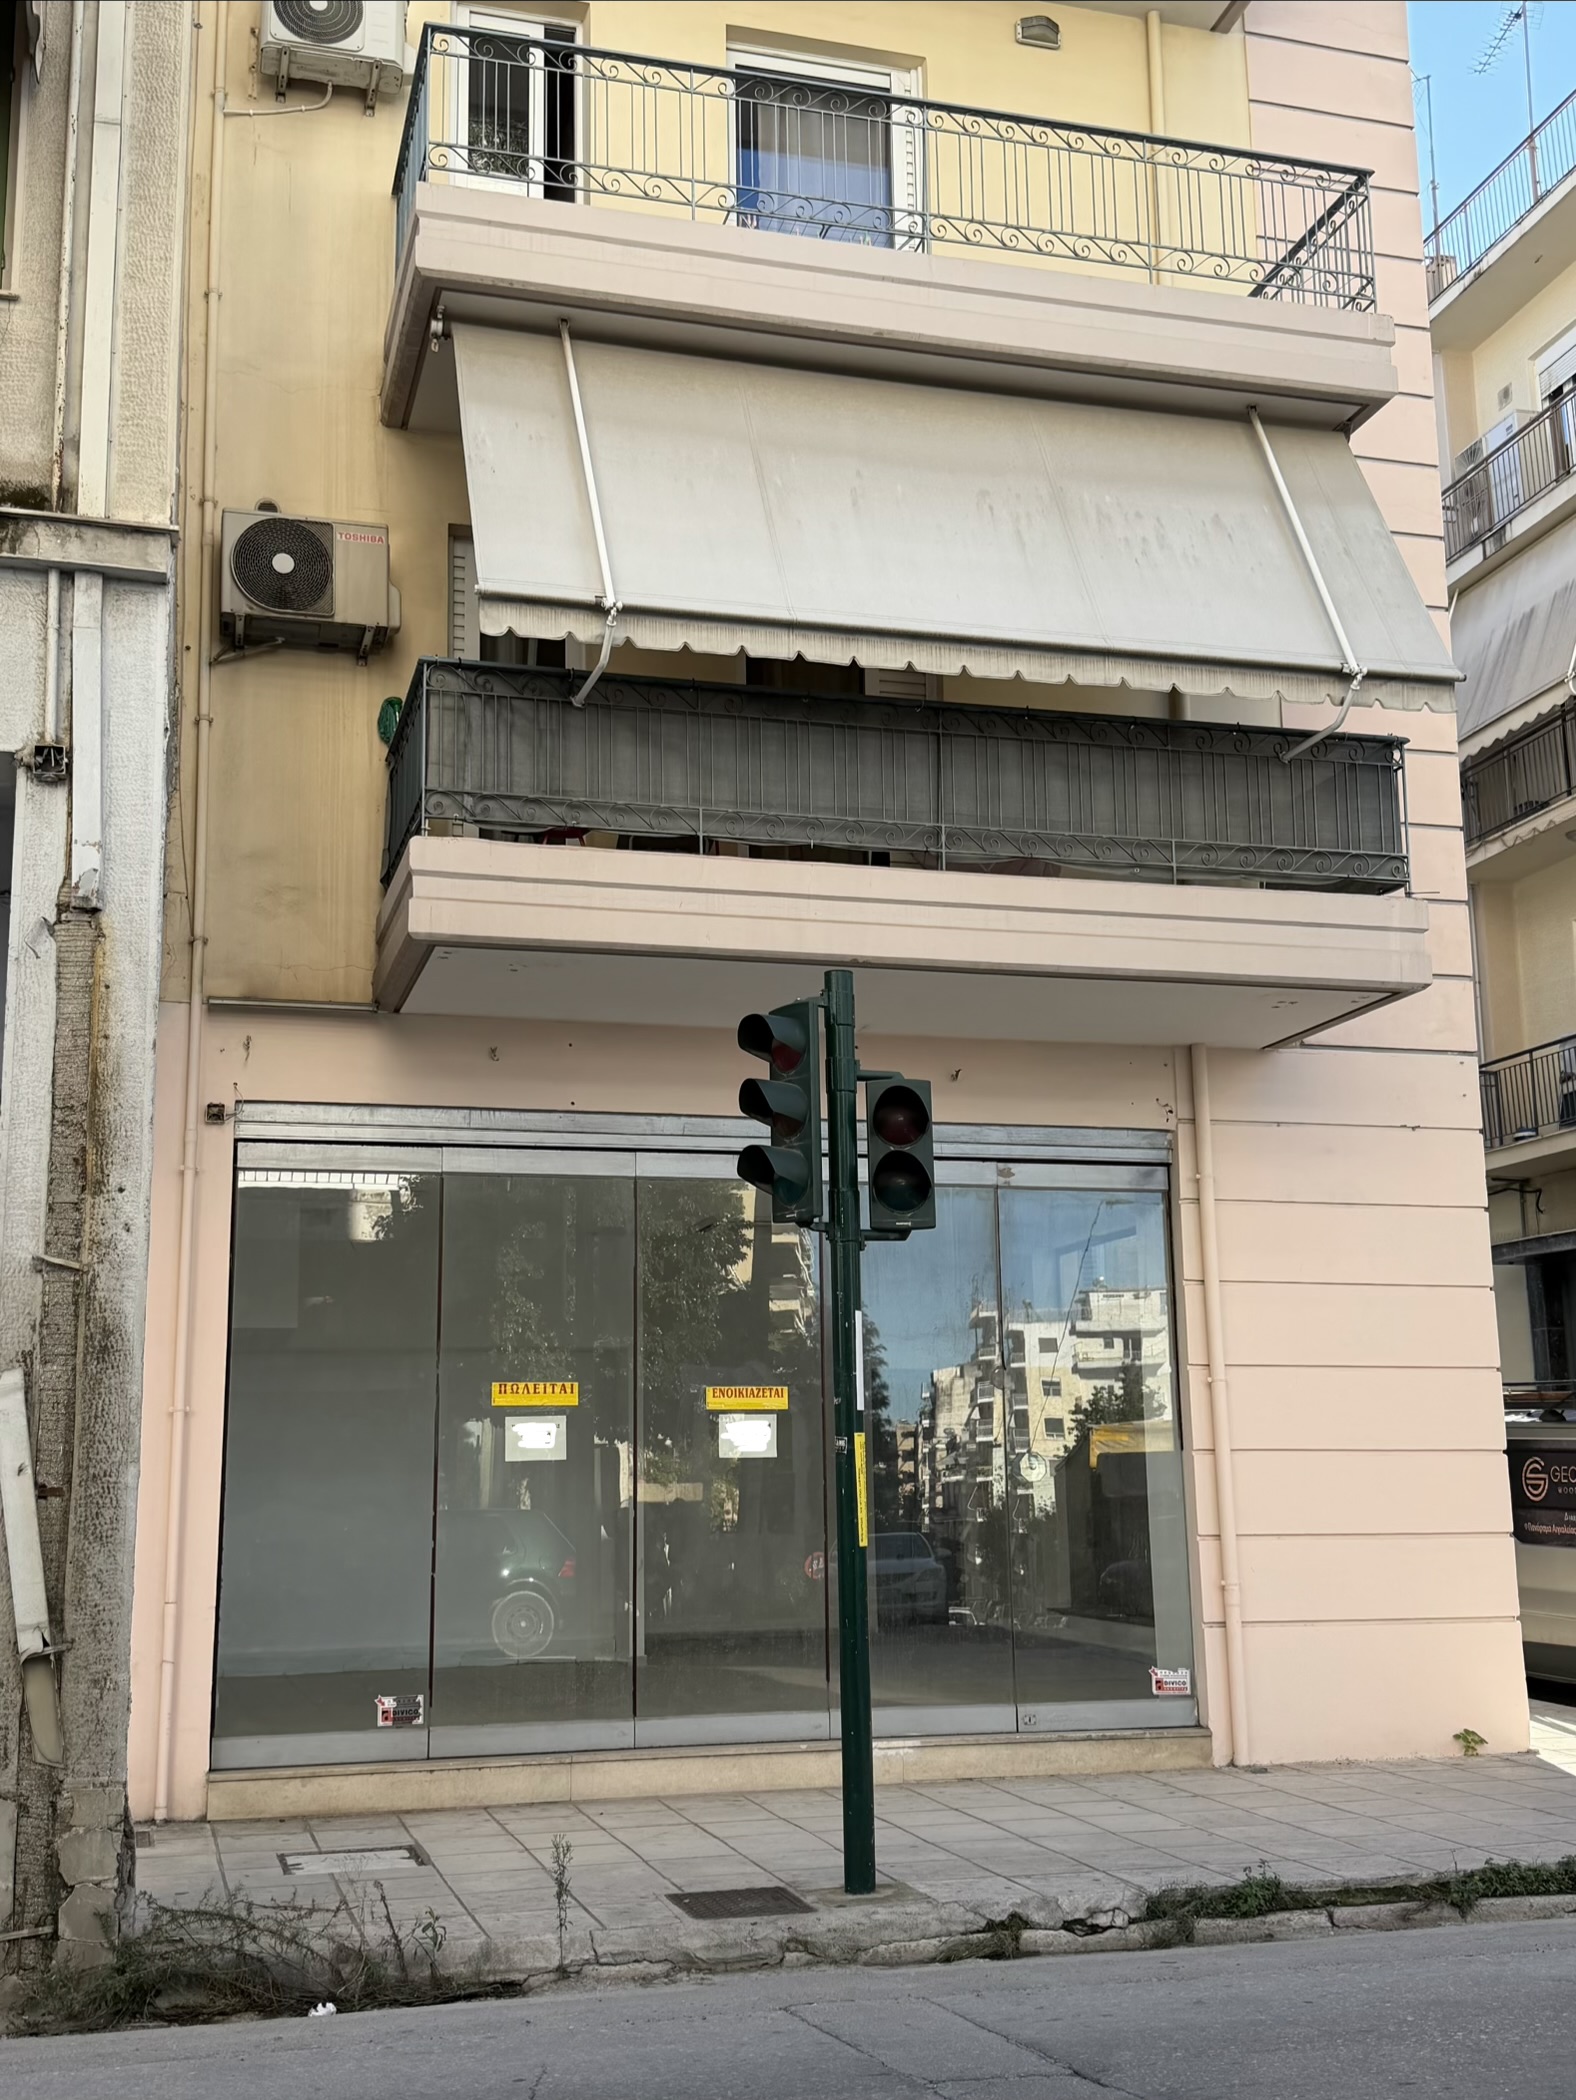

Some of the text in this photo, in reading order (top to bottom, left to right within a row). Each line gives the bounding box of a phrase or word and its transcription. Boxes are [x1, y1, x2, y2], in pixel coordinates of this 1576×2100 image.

[338, 532, 385, 544] TOSHIBA
[498, 1383, 575, 1395] ΠΩΛΕΙΤΑΙ
[712, 1387, 784, 1399] ΕΝΟΙΚΙΑΖΕΤΑΙ
[392, 1708, 419, 1717] DIVICO
